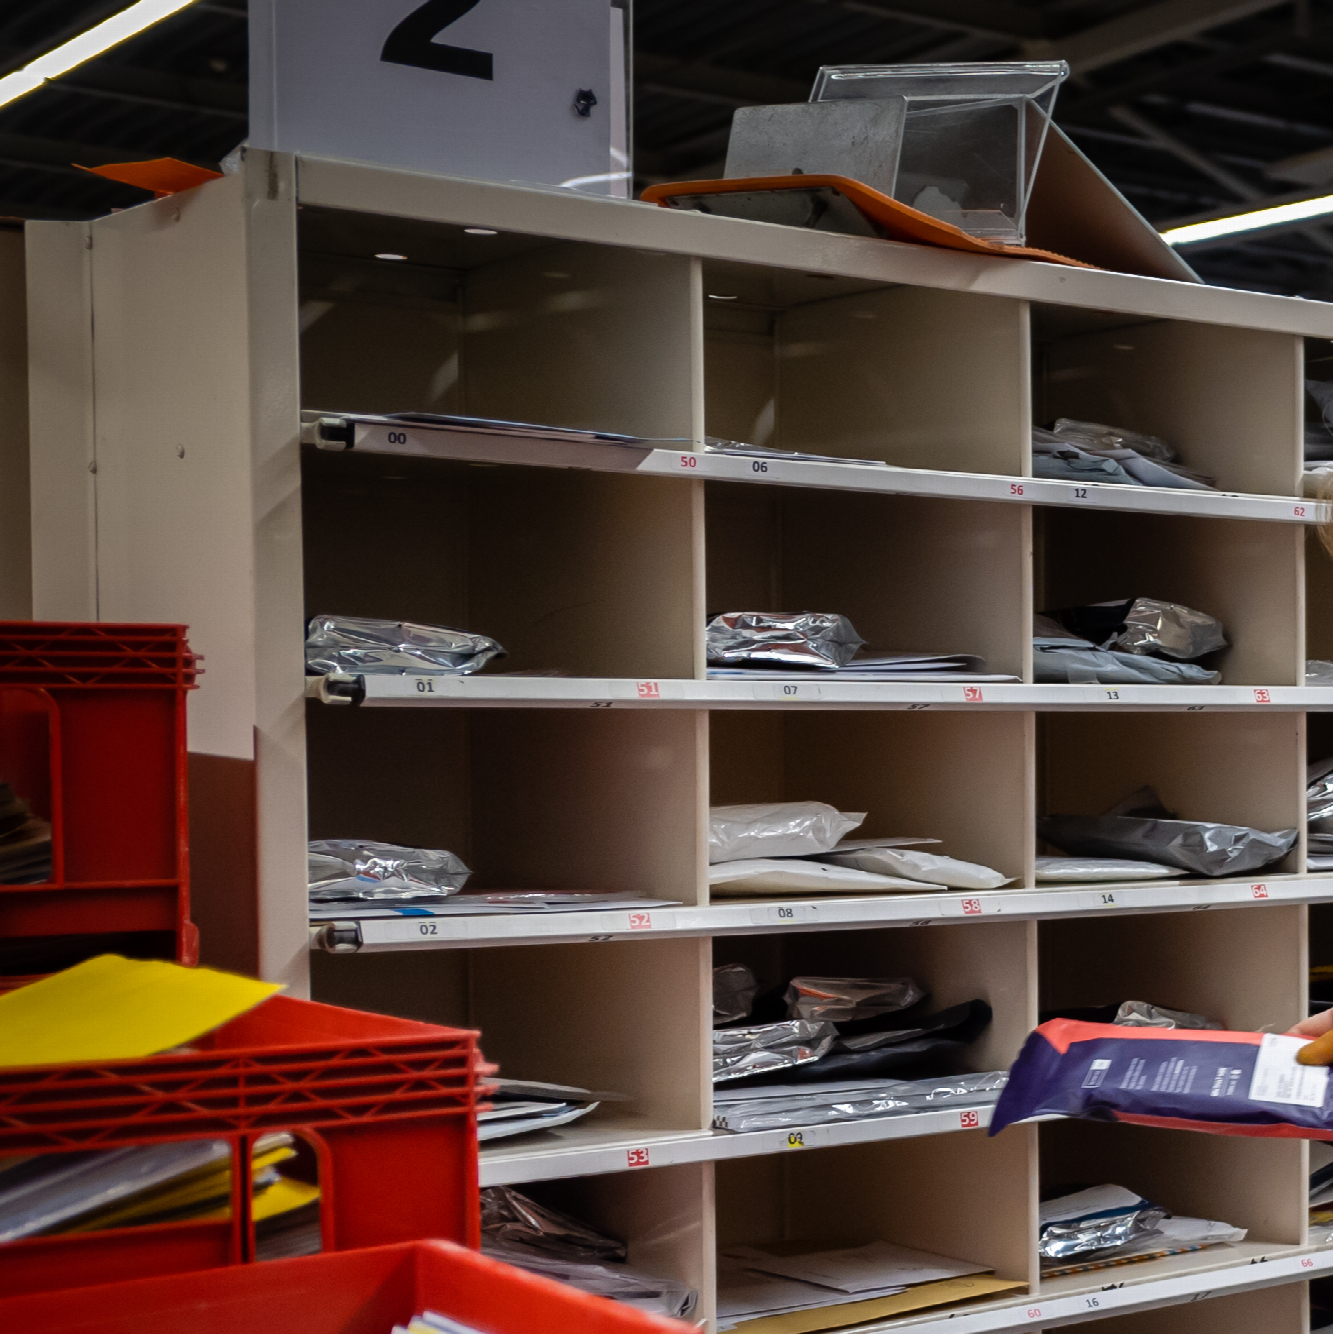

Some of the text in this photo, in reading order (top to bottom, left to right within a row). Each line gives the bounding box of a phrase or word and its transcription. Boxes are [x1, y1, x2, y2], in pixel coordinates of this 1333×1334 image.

[388, 431, 407, 446] 00
[680, 456, 697, 468] 50
[752, 460, 768, 474] 06
[1009, 484, 1024, 495] 56
[1074, 488, 1088, 499] 12
[1294, 506, 1305, 517] 62
[416, 681, 435, 694] 01
[636, 682, 660, 698] 51
[783, 685, 798, 695] 07
[963, 686, 984, 702] 57
[1106, 690, 1119, 700] 13
[1254, 688, 1271, 702] 63
[1251, 883, 1269, 898] 64
[1102, 893, 1114, 904] 14
[961, 898, 982, 914] 58
[778, 907, 793, 919] 08
[628, 912, 651, 929] 52
[419, 924, 438, 936] 02
[960, 1110, 979, 1128] 59
[627, 1147, 649, 1168] 53
[1300, 1258, 1314, 1268] 66
[1085, 1297, 1100, 1308] 16
[1027, 1308, 1042, 1318] 60
